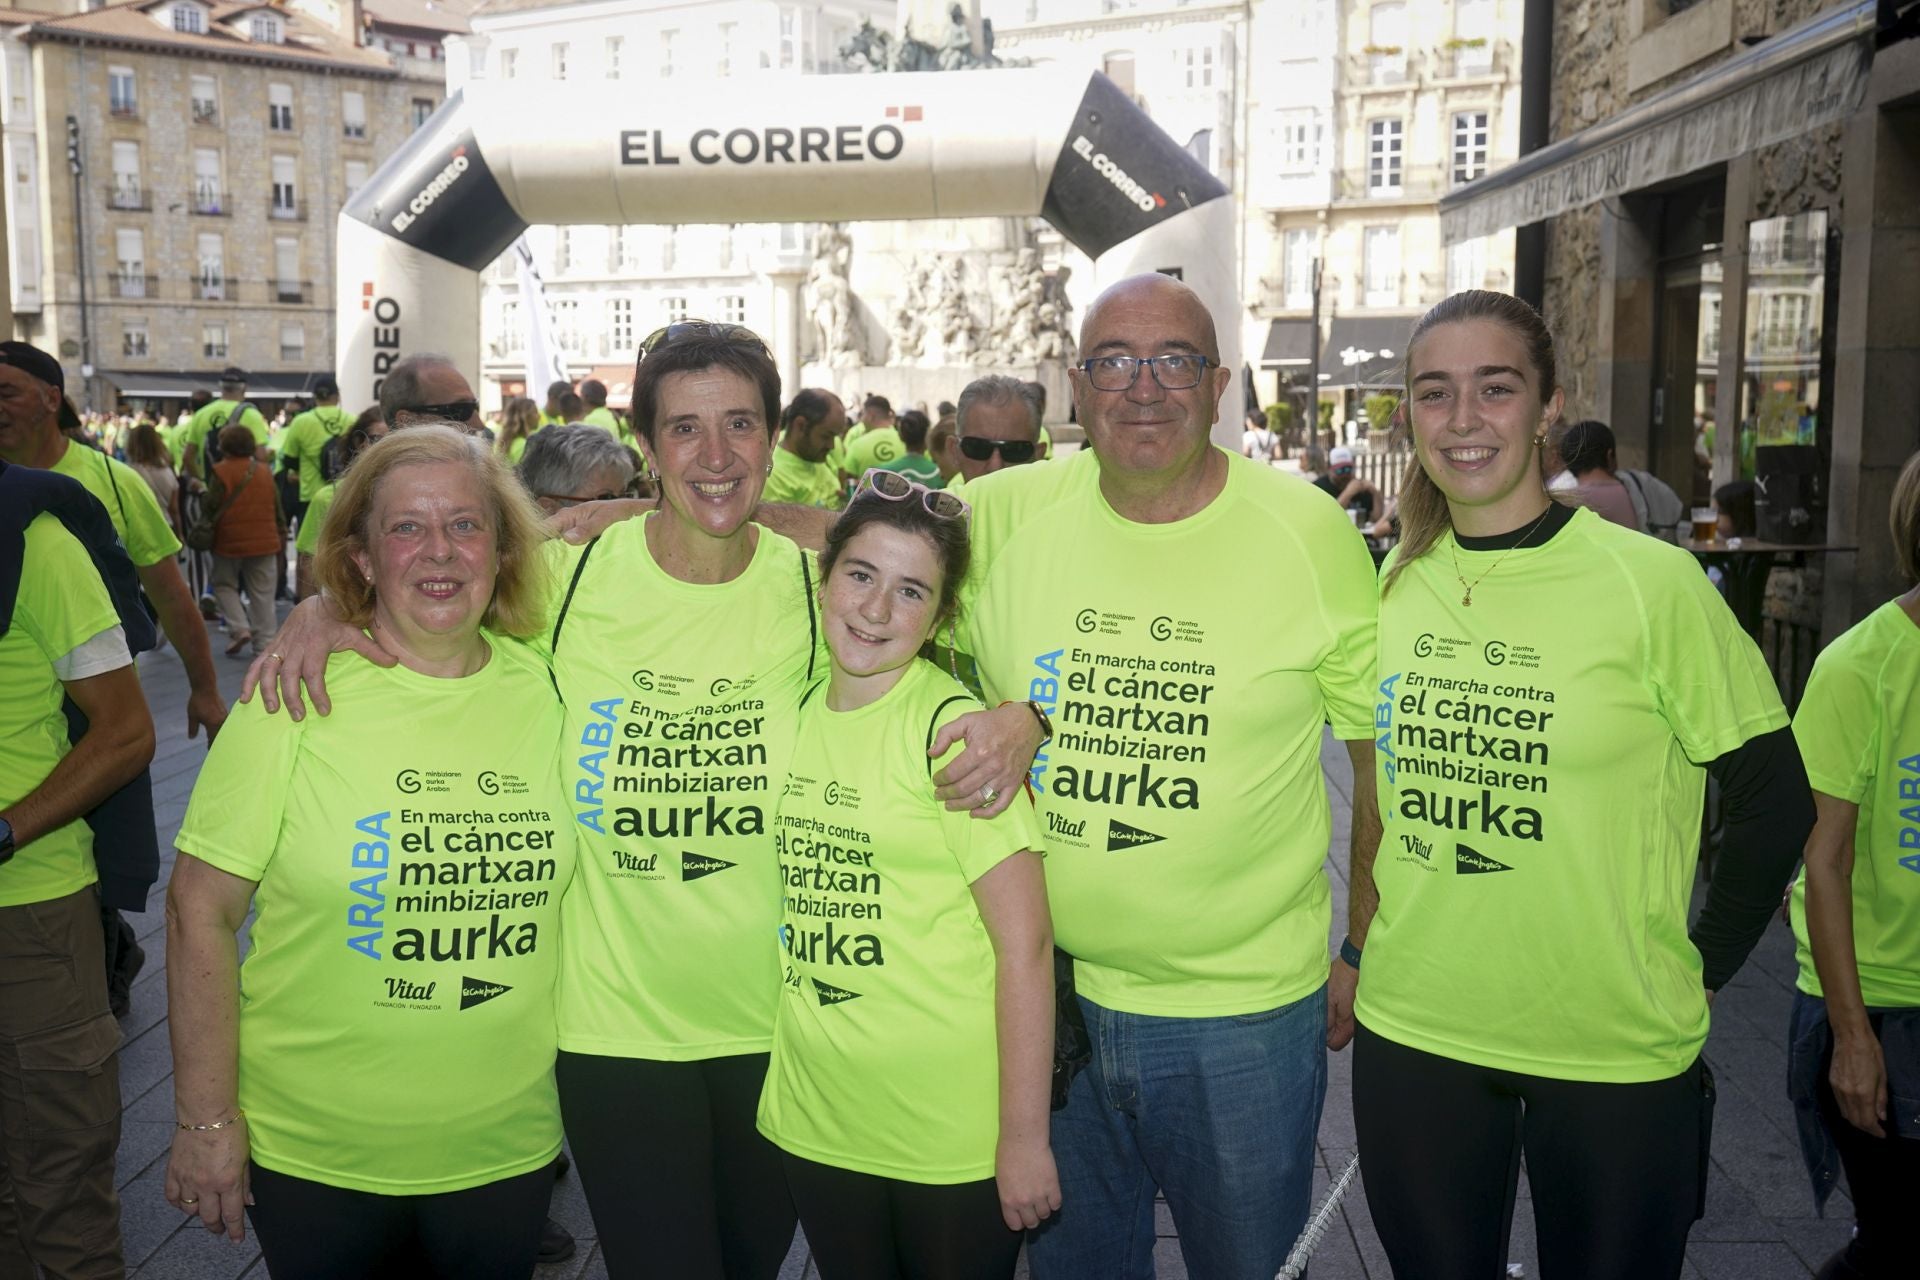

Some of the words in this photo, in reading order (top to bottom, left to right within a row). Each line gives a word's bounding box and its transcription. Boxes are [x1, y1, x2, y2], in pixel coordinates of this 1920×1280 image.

[620, 130, 680, 164] EL
[690, 124, 903, 164] CORREO
[1072, 135, 1094, 162] EL
[1092, 153, 1156, 212] CORREO
[392, 210, 416, 233] EL
[410, 156, 469, 214] CORREO
[1102, 613, 1136, 621] minbiziaren
[1435, 652, 1456, 660] Araban
[1438, 637, 1472, 647] minbiziaren
[1513, 645, 1535, 653] contra
[1071, 648, 1092, 663] En
[1095, 652, 1156, 671] marcha
[1160, 658, 1216, 676] contra
[659, 674, 695, 683] minbiziaren
[1067, 667, 1096, 694] el
[1104, 672, 1214, 704] cáncer
[1406, 672, 1424, 687] En
[1428, 676, 1488, 695] marcha
[1493, 684, 1555, 703] contra
[630, 700, 650, 717] En
[714, 699, 764, 714] contra
[1063, 700, 1209, 736] martxan
[1400, 689, 1426, 716] el
[1435, 695, 1553, 732] cáncer
[624, 721, 653, 738] el
[661, 716, 764, 741] cáncer
[617, 743, 767, 768] martxan
[1058, 730, 1206, 763] minbiziaren
[1398, 723, 1549, 765] martxan
[576, 698, 624, 835] ARABA
[1397, 754, 1548, 793] minbiziaren
[613, 772, 768, 792] minbiziaren
[1052, 764, 1200, 810] aurka
[401, 810, 424, 824] En
[429, 810, 494, 824] marcha
[498, 808, 551, 824] contra
[613, 796, 764, 838] aurka
[1046, 811, 1086, 838] Vital
[1400, 788, 1543, 842] aurka
[401, 826, 434, 853] el
[444, 826, 555, 853] cáncer
[784, 818, 824, 833] marcha
[828, 824, 871, 843] contra
[612, 850, 658, 872] Vital
[792, 833, 874, 867] cáncer
[1400, 834, 1433, 861] Vital
[347, 810, 391, 960] ARABA
[400, 856, 556, 886] martxan
[396, 889, 549, 912] minbiziaren
[392, 914, 538, 961] aurka
[384, 977, 436, 1000] Vital
